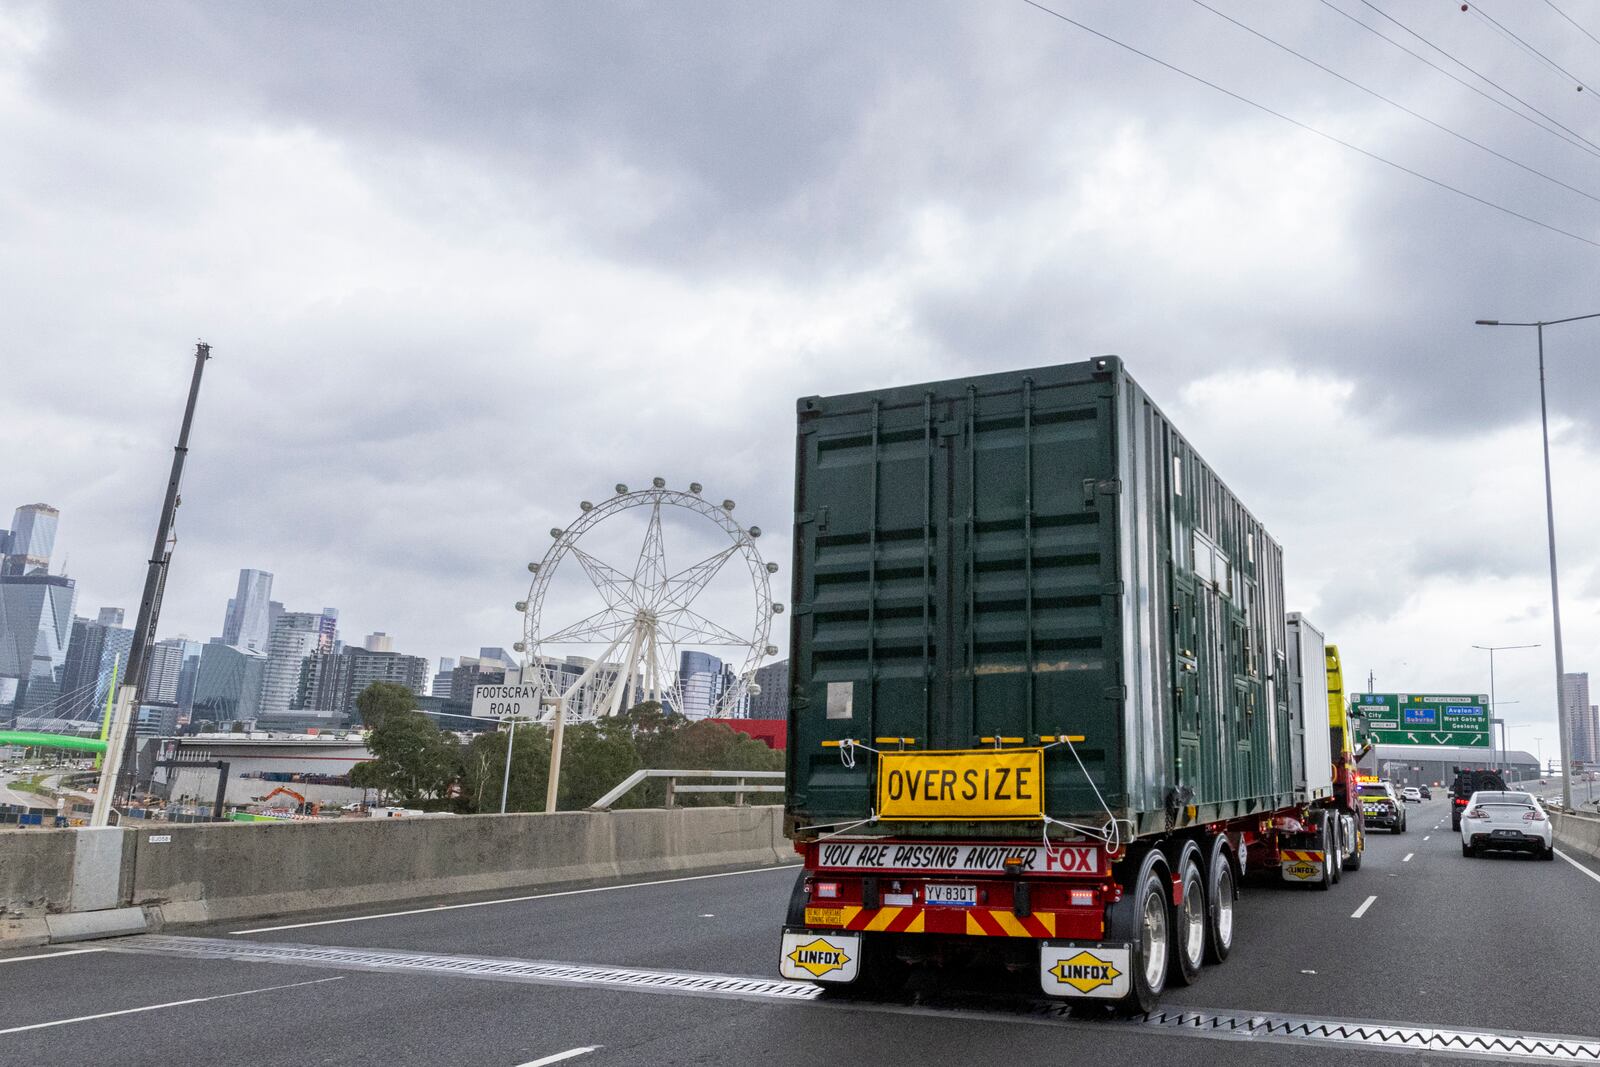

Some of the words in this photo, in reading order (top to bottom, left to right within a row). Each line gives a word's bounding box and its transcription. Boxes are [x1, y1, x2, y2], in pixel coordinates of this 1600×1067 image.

[476, 686, 538, 698] FOOTSCRAY
[490, 703, 521, 715] ROAD
[888, 767, 1032, 801] OVERSIZE
[822, 845, 855, 866] YOU
[856, 845, 890, 867] ARE
[892, 846, 959, 868] PASSING
[1046, 847, 1092, 871] FOX
[798, 950, 841, 965] LINFOX
[1060, 965, 1109, 980] LINFOX
